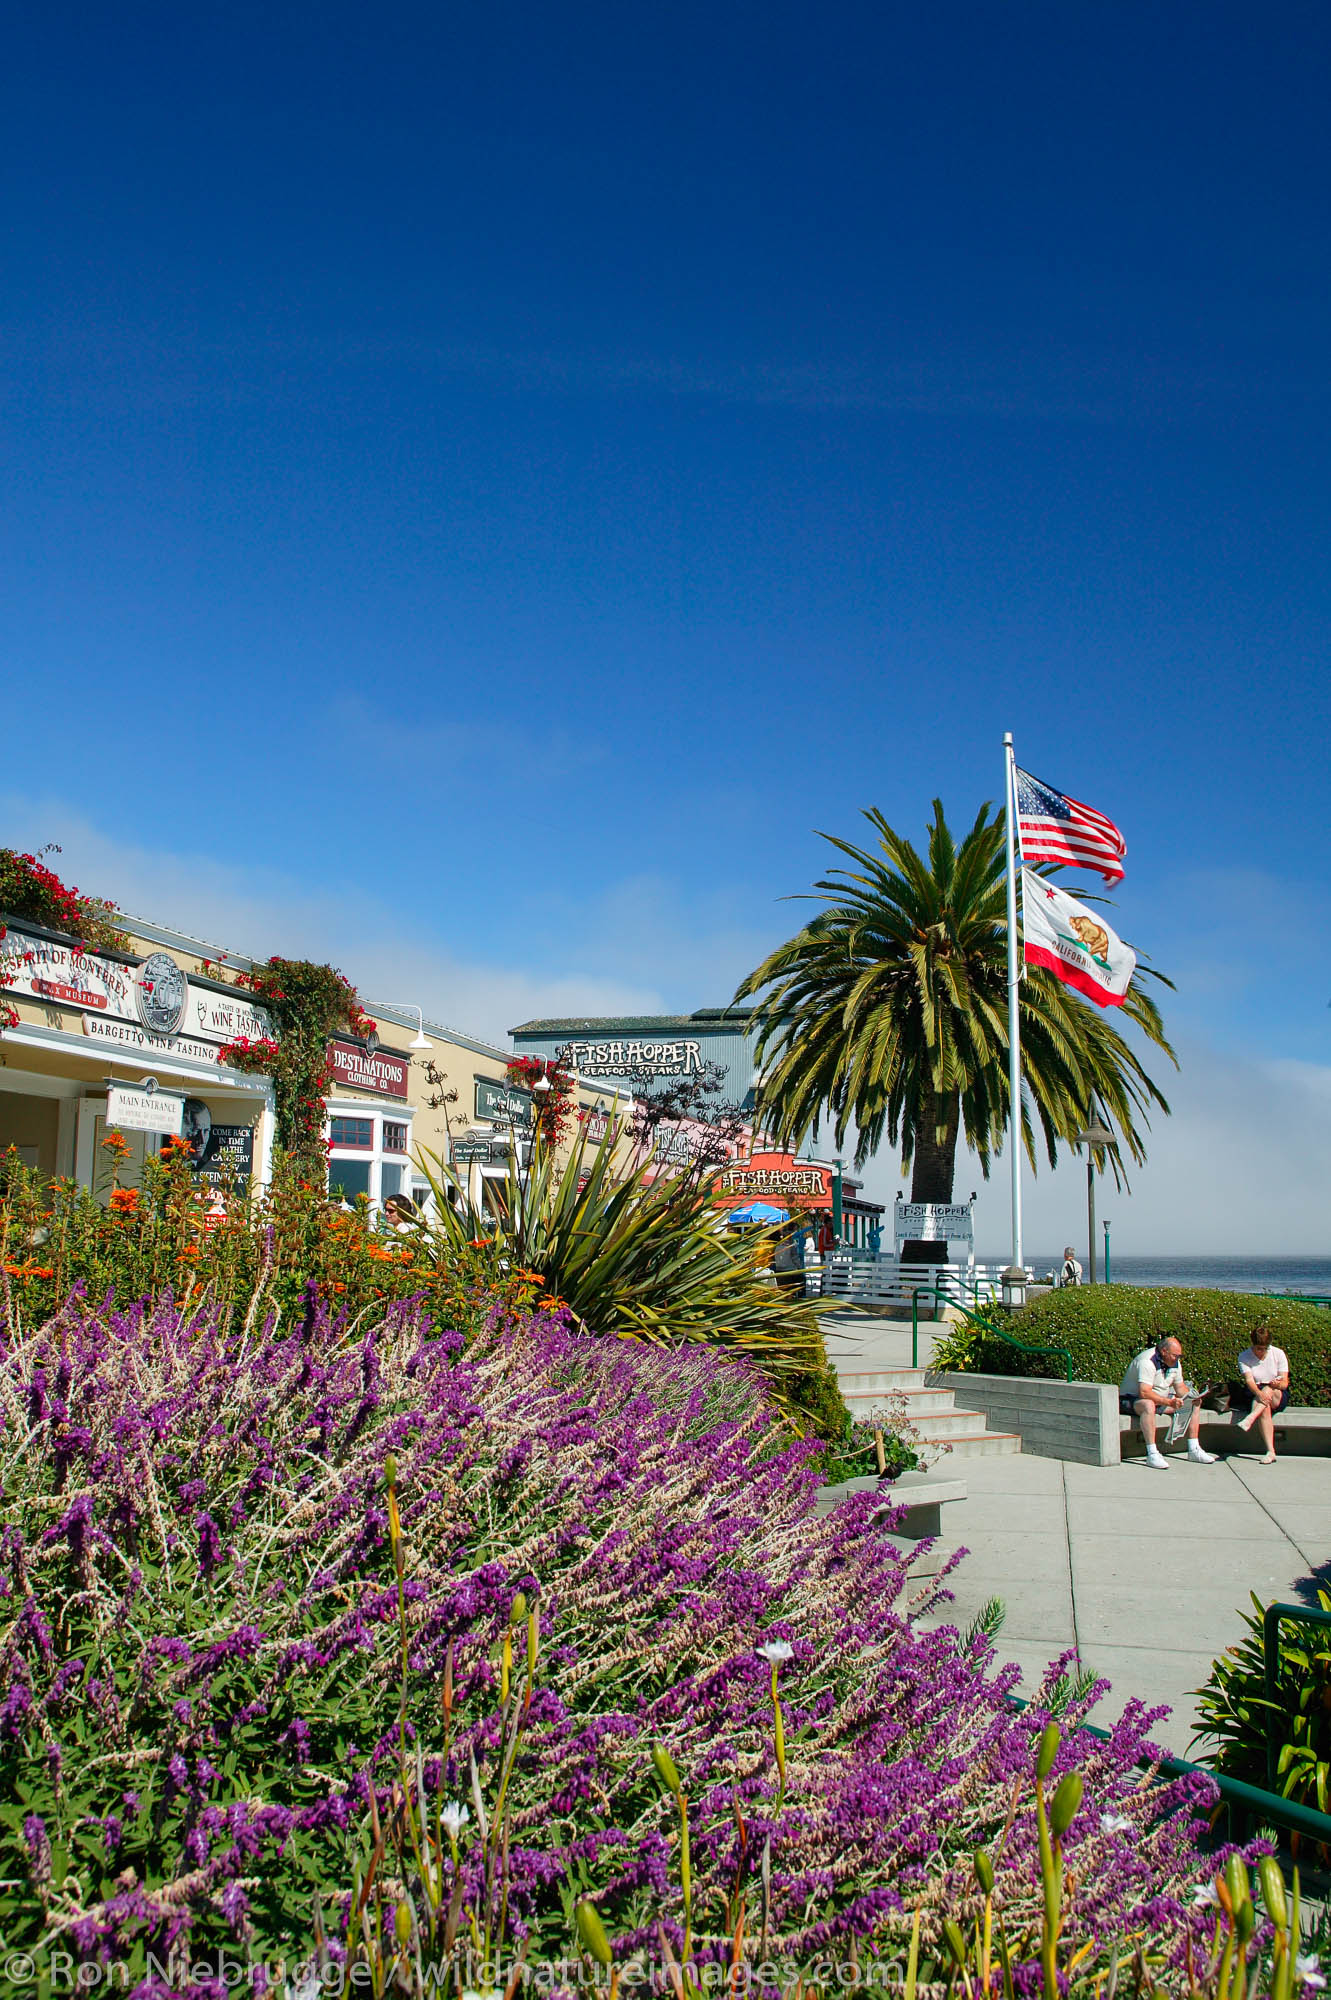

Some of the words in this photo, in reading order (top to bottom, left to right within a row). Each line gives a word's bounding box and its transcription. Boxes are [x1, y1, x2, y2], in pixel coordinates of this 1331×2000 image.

[52, 951, 66, 965] OF
[70, 952, 128, 1001] MONTEREY
[65, 989, 100, 1006] MUSEUM
[222, 1003, 234, 1012] TASTE
[211, 1011, 233, 1028] WINE
[236, 1014, 270, 1039] TASTING
[91, 1021, 144, 1044] BARGETTO
[148, 1033, 172, 1051] WINE
[177, 1042, 214, 1060] TASTING
[570, 1042, 623, 1067] FISH
[626, 1041, 705, 1074] HOPPER
[334, 1050, 403, 1083] DESTINATIONS
[583, 1065, 632, 1076] SEAFOOD
[638, 1065, 681, 1076] STEAKS
[347, 1071, 377, 1087] CLOTHING
[119, 1095, 140, 1107] MAIN
[141, 1098, 176, 1113] ENTRANCE
[213, 1128, 232, 1136] COME
[233, 1129, 251, 1137] BACK
[219, 1137, 227, 1145] IN
[228, 1138, 245, 1146] TIME
[229, 1146, 243, 1154] THE
[729, 1170, 767, 1194] FISH
[770, 1169, 826, 1195] HOPPER
[778, 1186, 809, 1195] STEAKS
[904, 1205, 926, 1216] FISH
[931, 1205, 968, 1216] HOPPER
